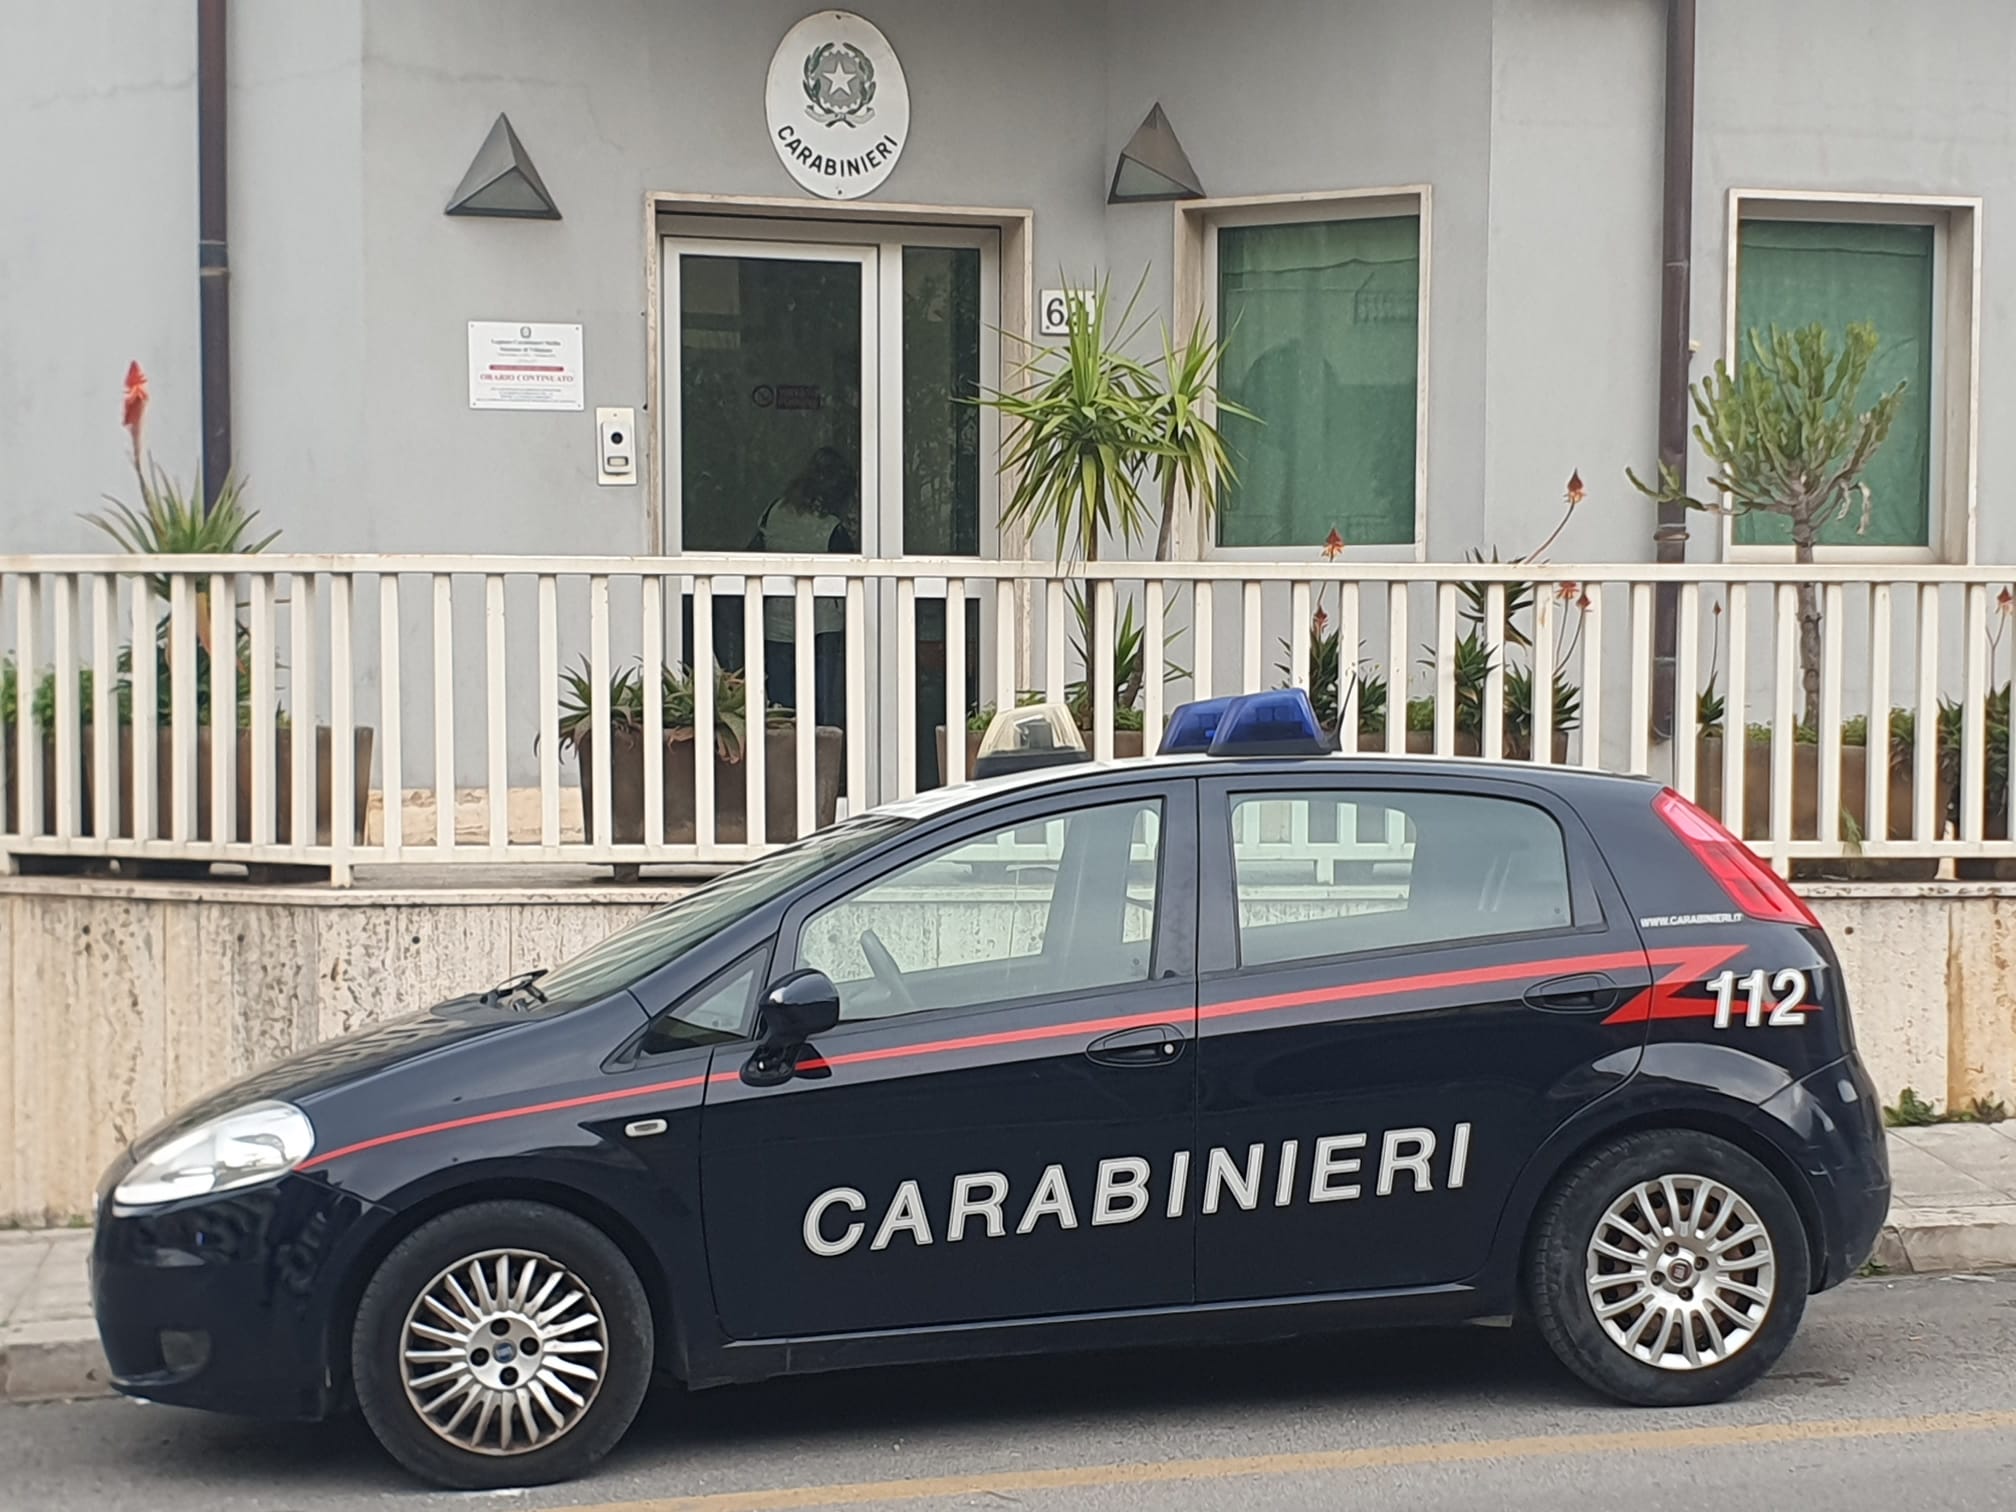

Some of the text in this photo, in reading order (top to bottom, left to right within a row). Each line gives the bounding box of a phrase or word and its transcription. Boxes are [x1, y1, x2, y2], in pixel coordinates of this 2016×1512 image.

[777, 125, 898, 177] CARABINIERI
[480, 373, 574, 383] ORARIO CONTINUATO
[1640, 913, 1744, 928] WWW.CARABINIERI.IT
[1706, 968, 1807, 1029] 112
[802, 1122, 1471, 1257] CARABINIERI
